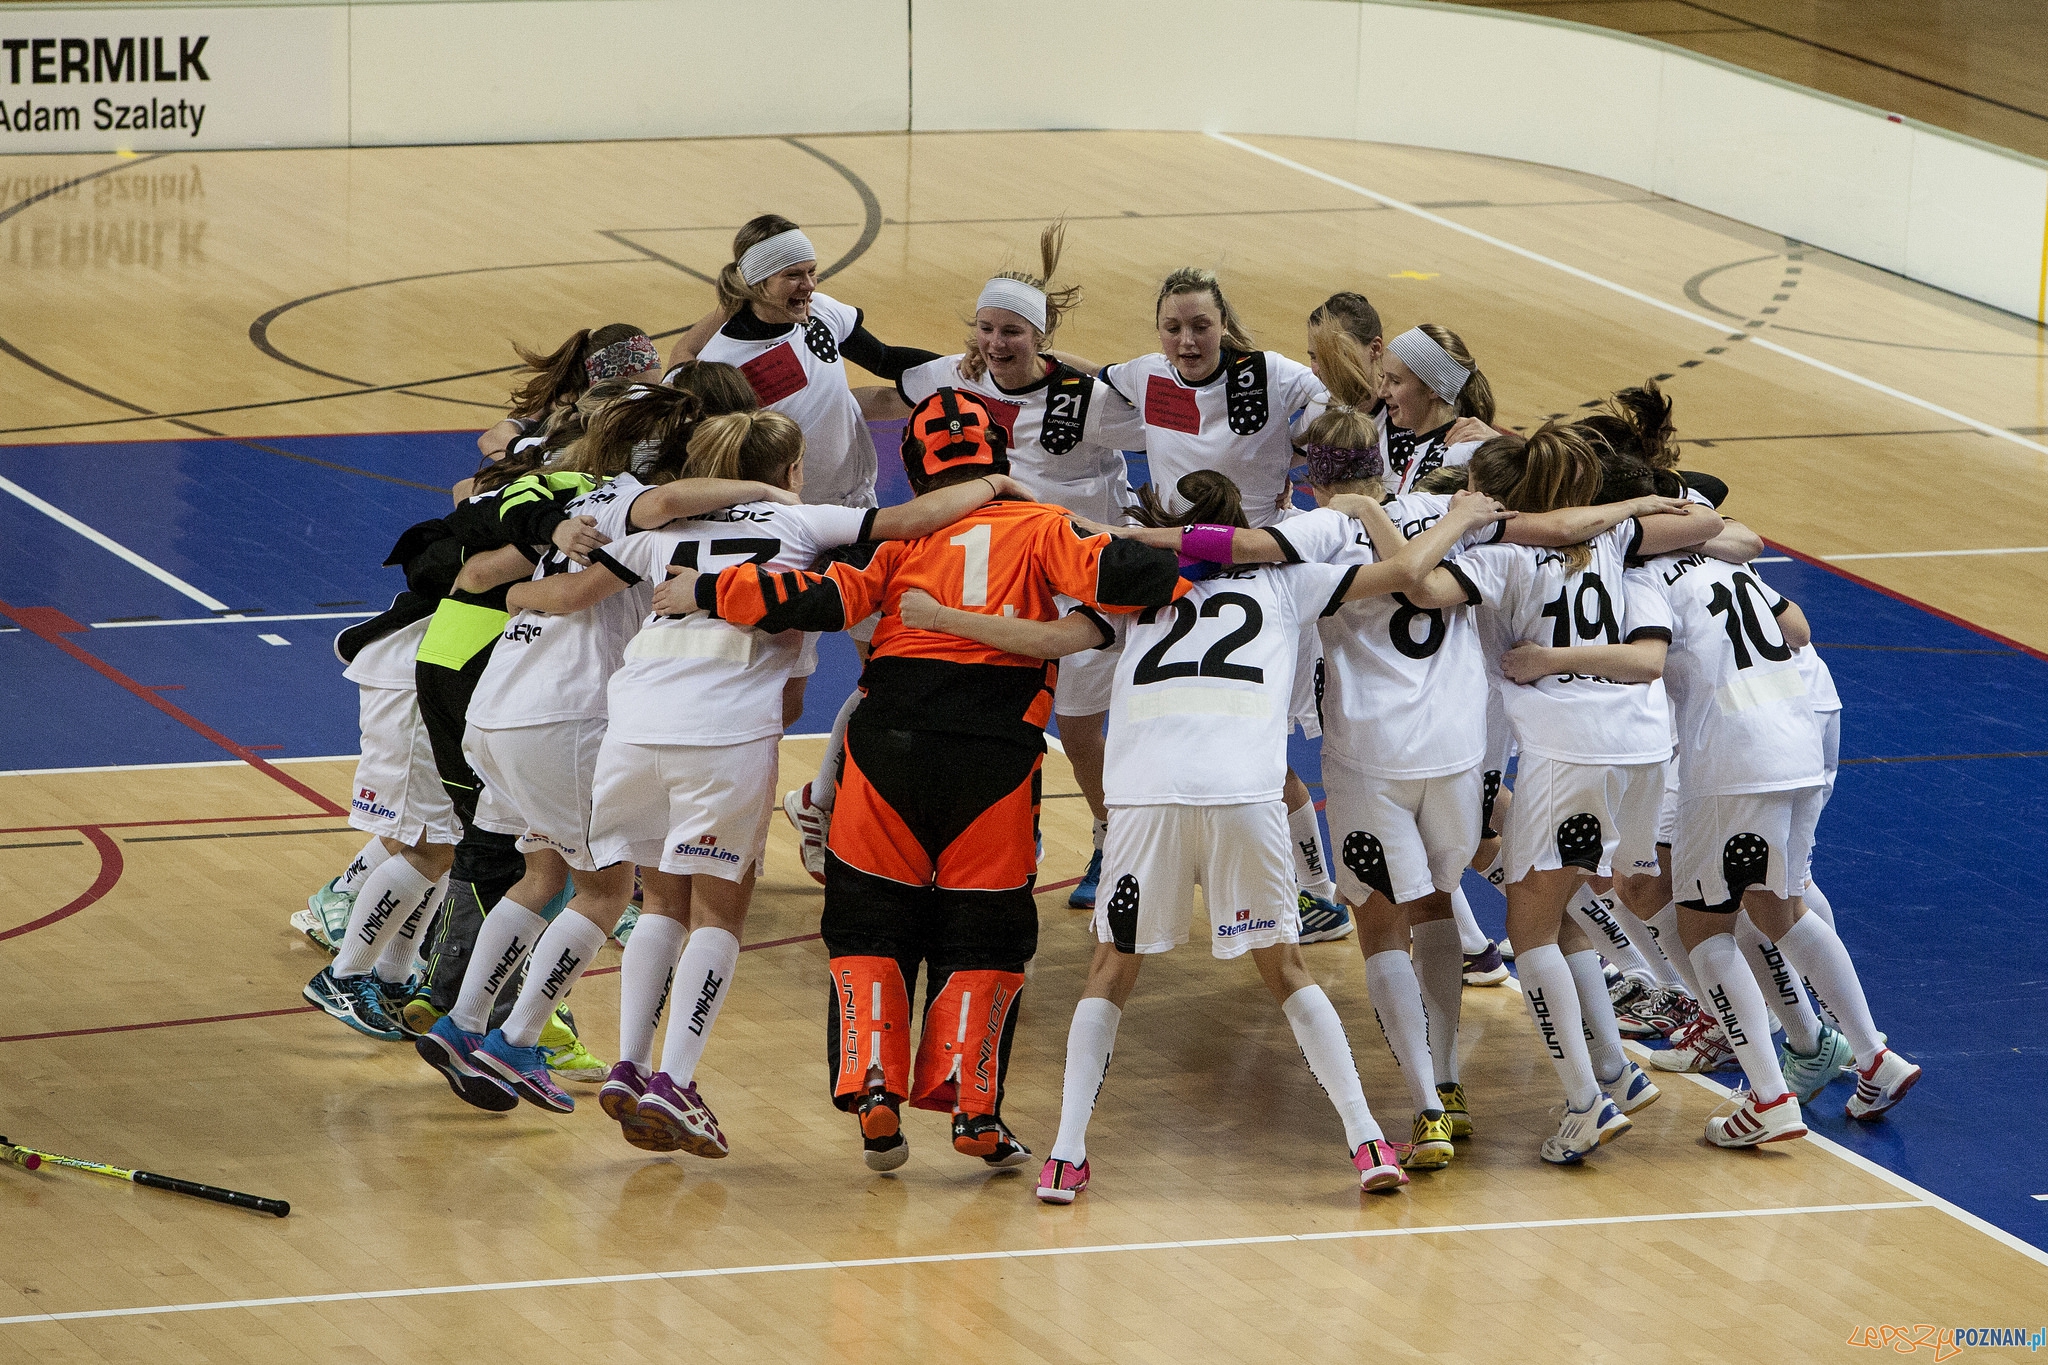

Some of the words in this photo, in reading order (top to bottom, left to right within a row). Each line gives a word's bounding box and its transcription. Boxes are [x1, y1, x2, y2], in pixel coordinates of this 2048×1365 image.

[0, 100, 80, 131] Adam
[94, 98, 206, 137] Szalaty
[1231, 389, 1264, 399] UNIHOC
[1237, 364, 1255, 388] 5
[1047, 418, 1080, 428] UNIHOC
[1051, 393, 1082, 419] 21
[949, 524, 992, 607] 1
[1541, 571, 1621, 648] 19
[1706, 571, 1792, 671] 10
[1133, 591, 1264, 686] 22
[369, 802, 396, 819] Line
[675, 843, 710, 856] Stena
[710, 846, 740, 863] Line
[1298, 836, 1323, 877] UNIHOC
[359, 889, 400, 945] UNIHOC
[1217, 922, 1248, 937] Stena
[1247, 919, 1277, 931] Line
[1580, 899, 1631, 950] UNIHOC
[484, 935, 527, 996] UNIHOC
[541, 947, 581, 1001] UNIHOC
[1758, 941, 1800, 1006] UNIHOC
[688, 969, 724, 1037] UNIHOC
[841, 969, 859, 1075] UNIHOC
[1527, 986, 1566, 1060] UNIHOC
[1709, 983, 1749, 1047] UNIHOC
[975, 982, 1008, 1094] UNIHOC
